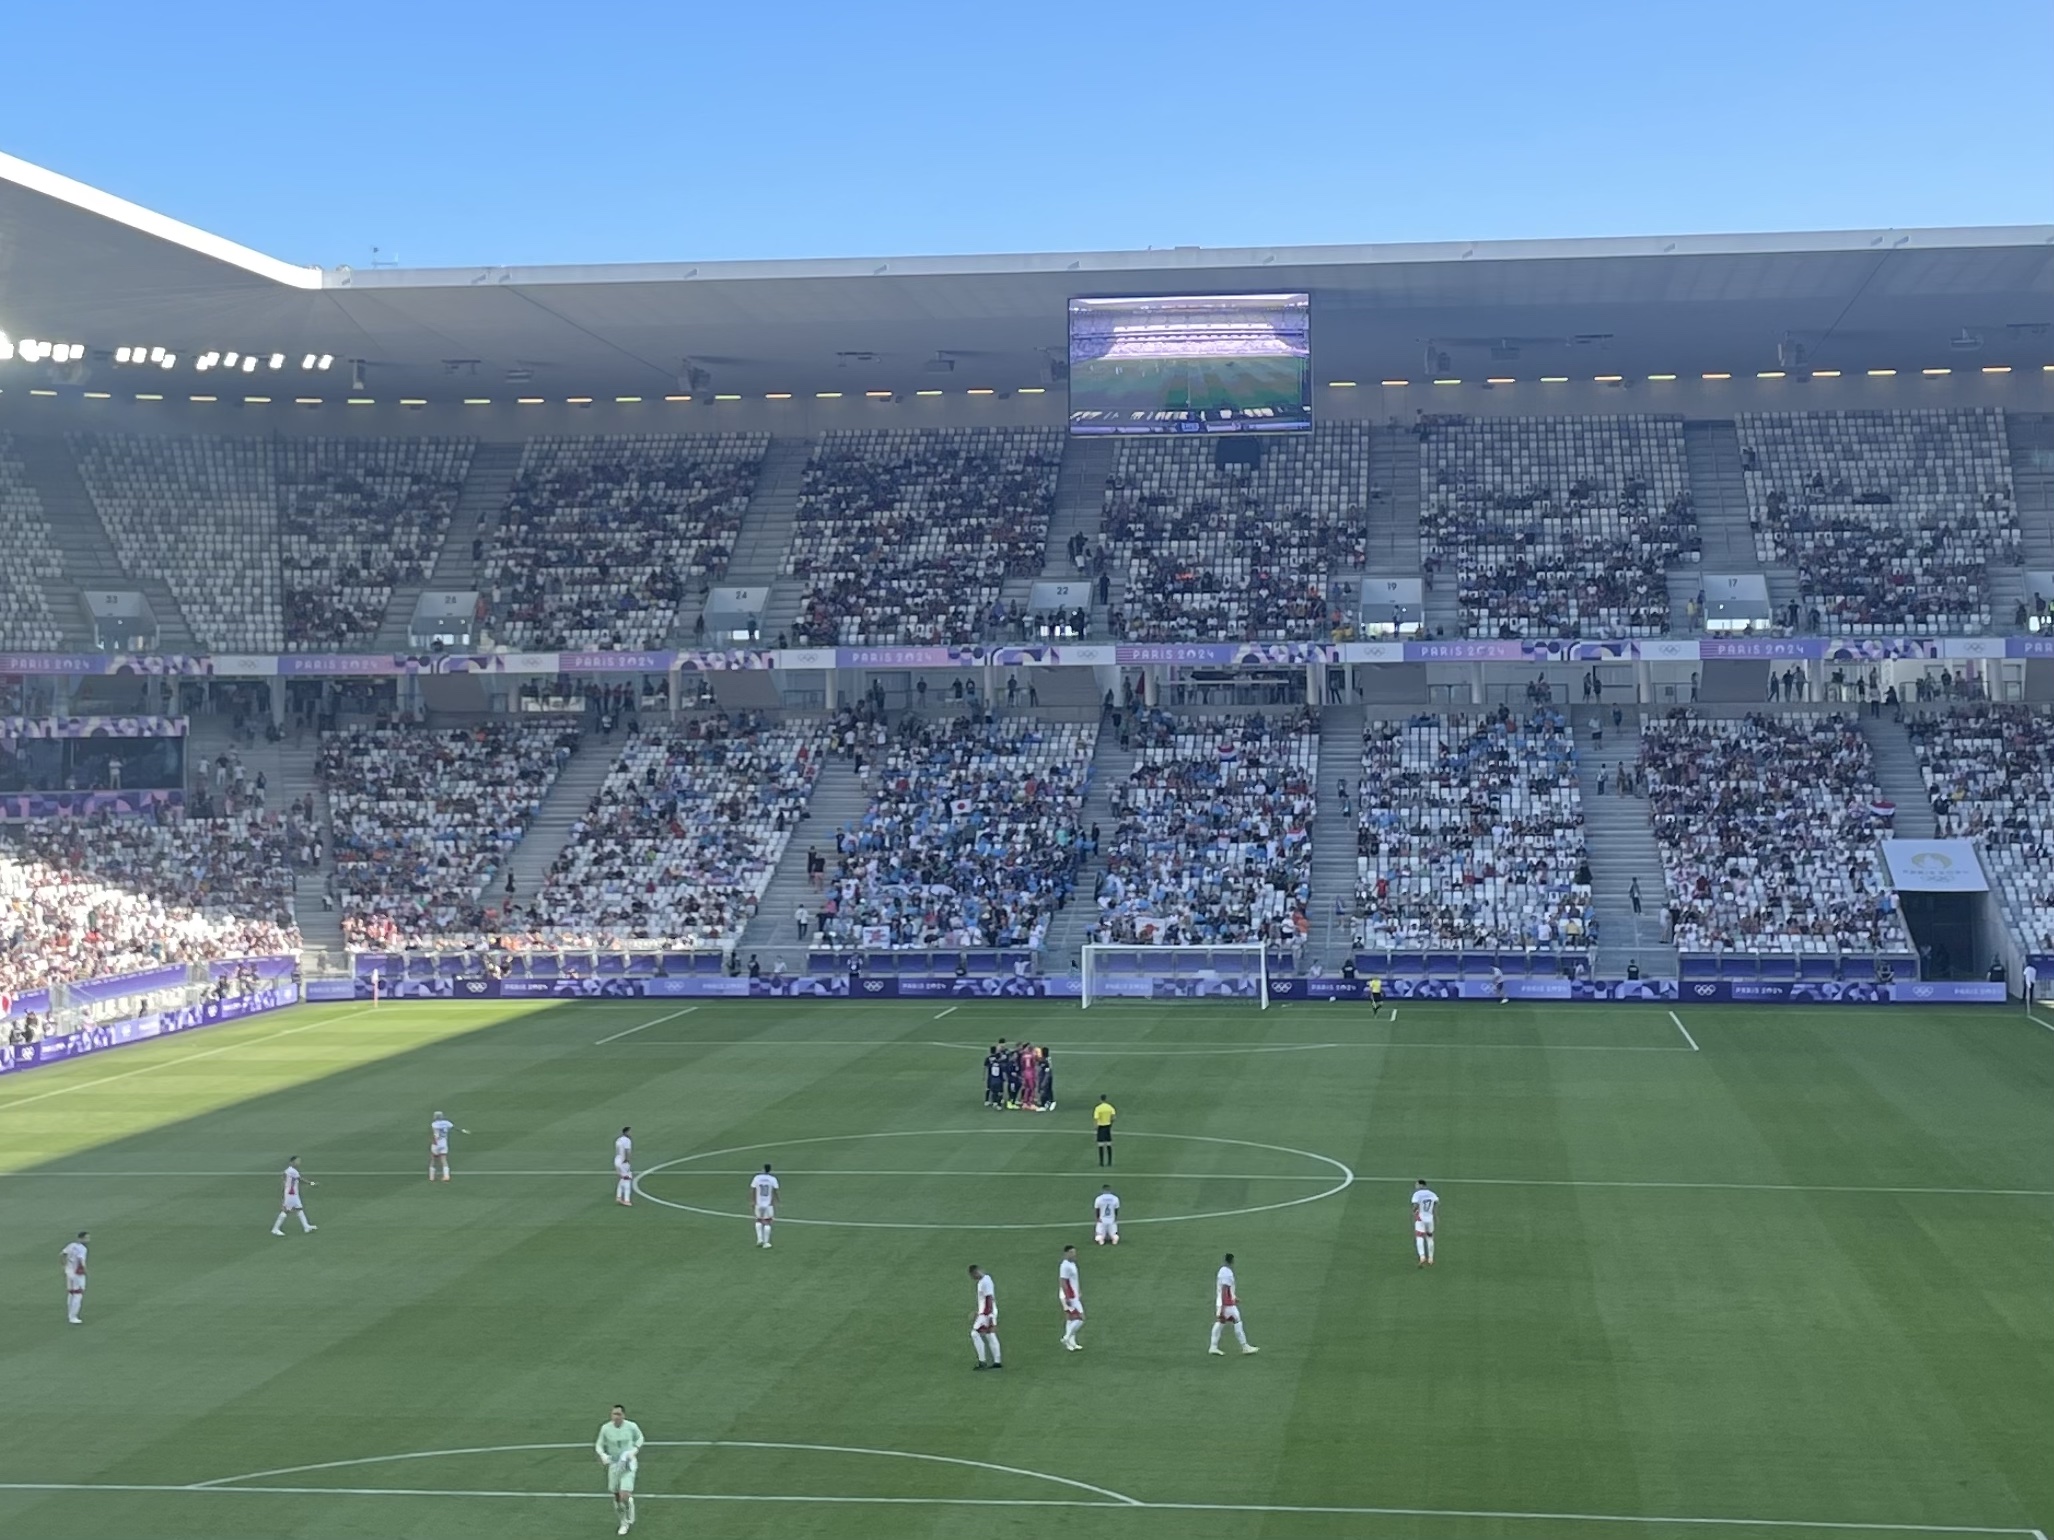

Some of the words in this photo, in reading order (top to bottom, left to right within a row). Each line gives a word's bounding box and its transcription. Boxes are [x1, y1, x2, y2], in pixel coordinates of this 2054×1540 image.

[1387, 582, 1397, 591] 19
[1728, 578, 1738, 588] 17
[1056, 586, 1069, 595] 22
[1133, 649, 1173, 659] PARIS
[1177, 649, 1214, 659] 2024
[1421, 646, 1462, 656] PARIS
[1718, 645, 1760, 655] PARIS
[1765, 644, 1804, 655] 2024
[618, 656, 654, 667] 2024
[896, 652, 932, 662] 2024
